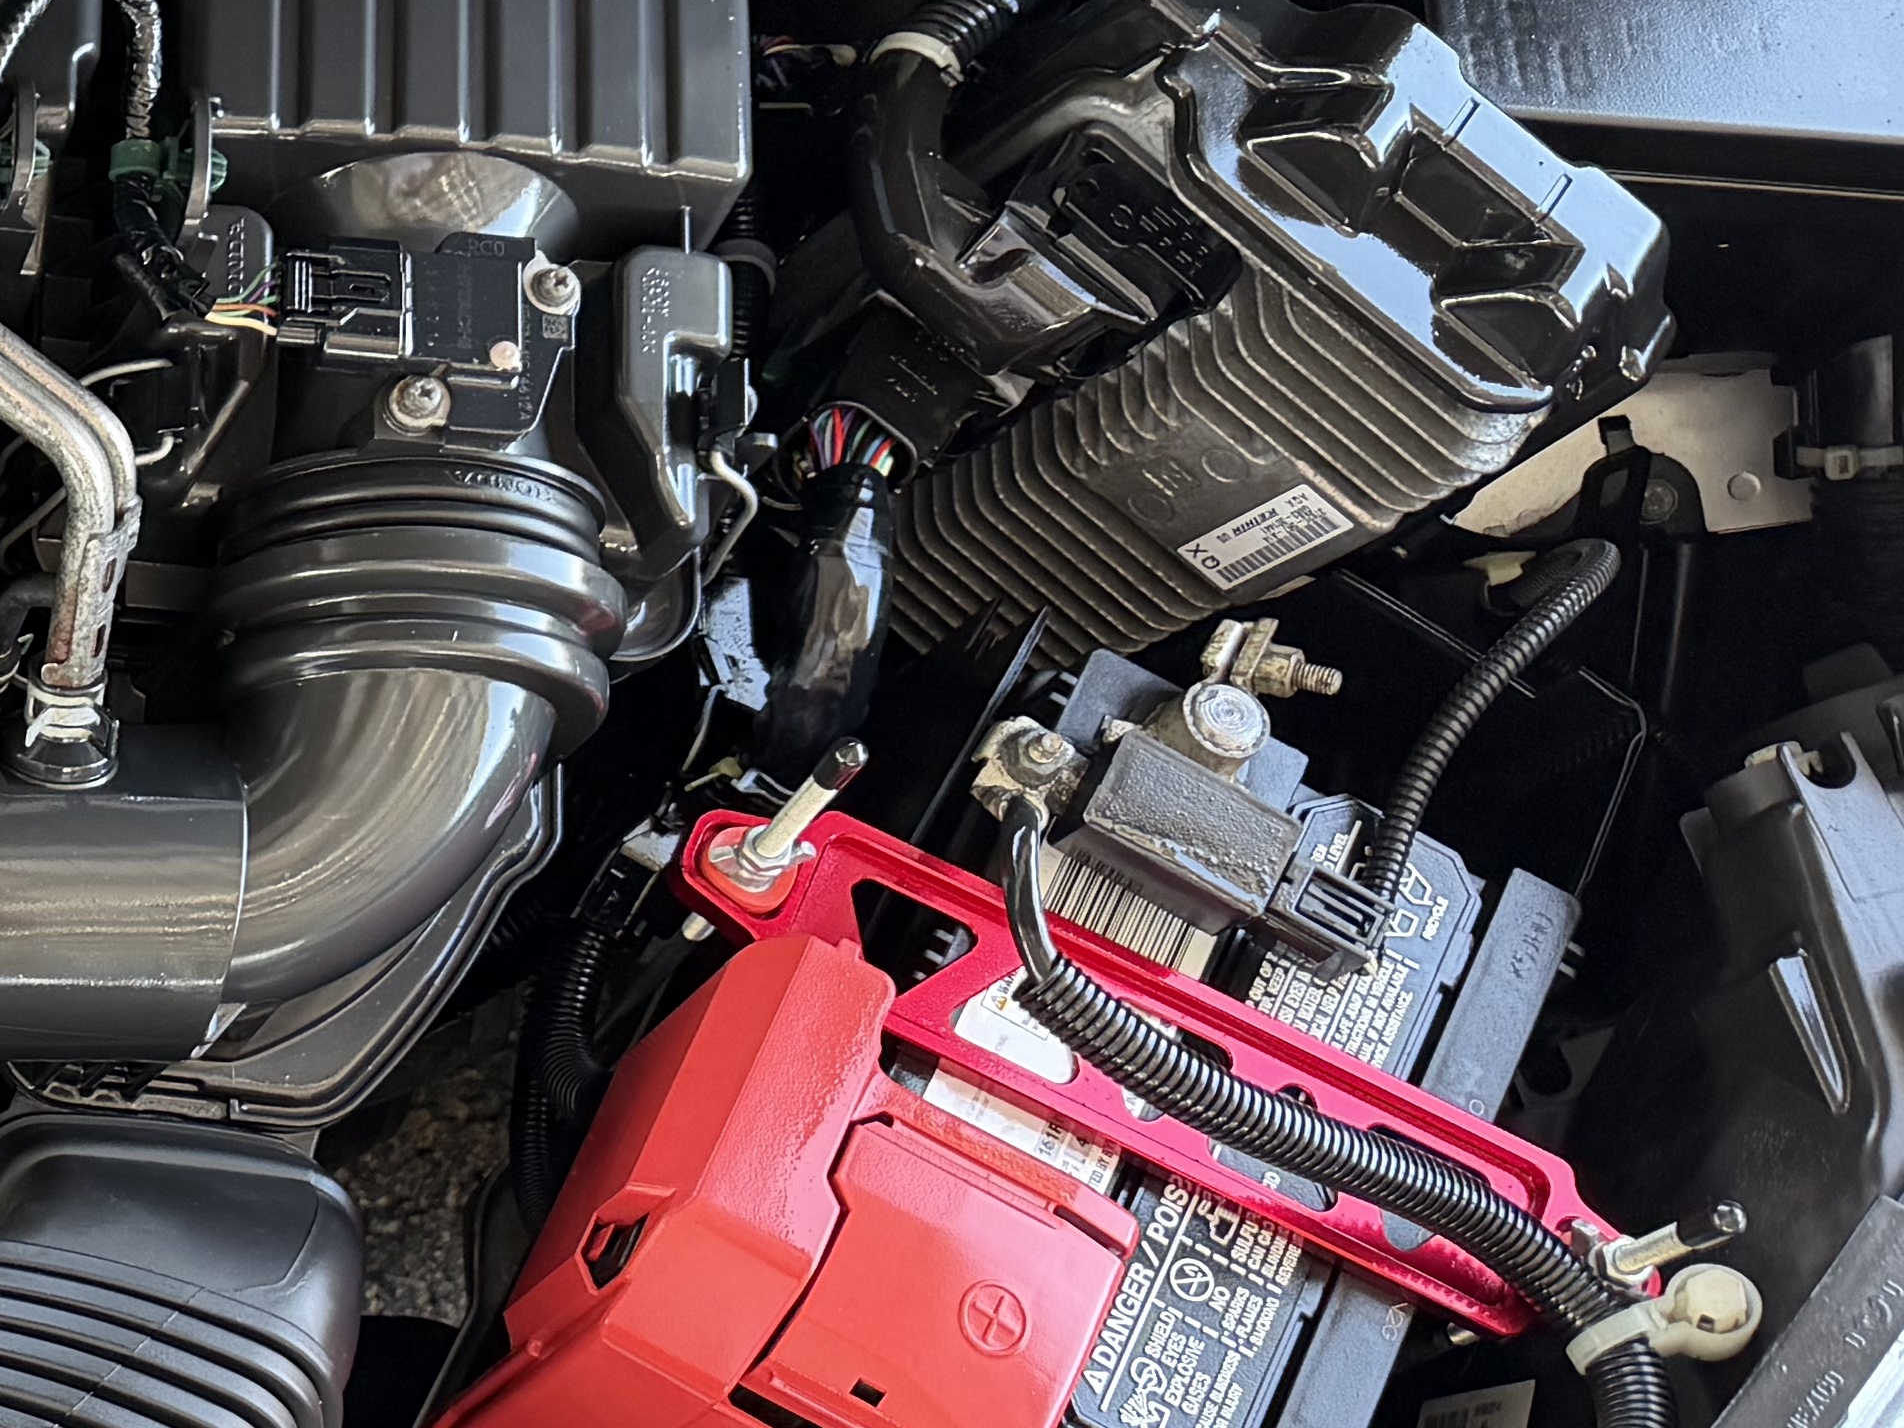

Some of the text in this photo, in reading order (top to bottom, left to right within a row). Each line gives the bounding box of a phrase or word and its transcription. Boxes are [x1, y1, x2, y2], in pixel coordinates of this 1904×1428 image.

[1283, 980, 1307, 1009] EYES
[1318, 985, 1342, 1015] HELP
[1090, 1259, 1156, 1368] DANGER
[1143, 1181, 1192, 1247] POIS
[1206, 1283, 1232, 1313] NO
[1220, 1284, 1250, 1332] SPARKS
[1234, 1293, 1264, 1338] FLAMES
[1143, 1308, 1178, 1359] SHIELD
[1159, 1330, 1188, 1368] EYES
[1163, 1334, 1207, 1406] EXPLOSIVE
[1179, 1370, 1212, 1417] GASES
